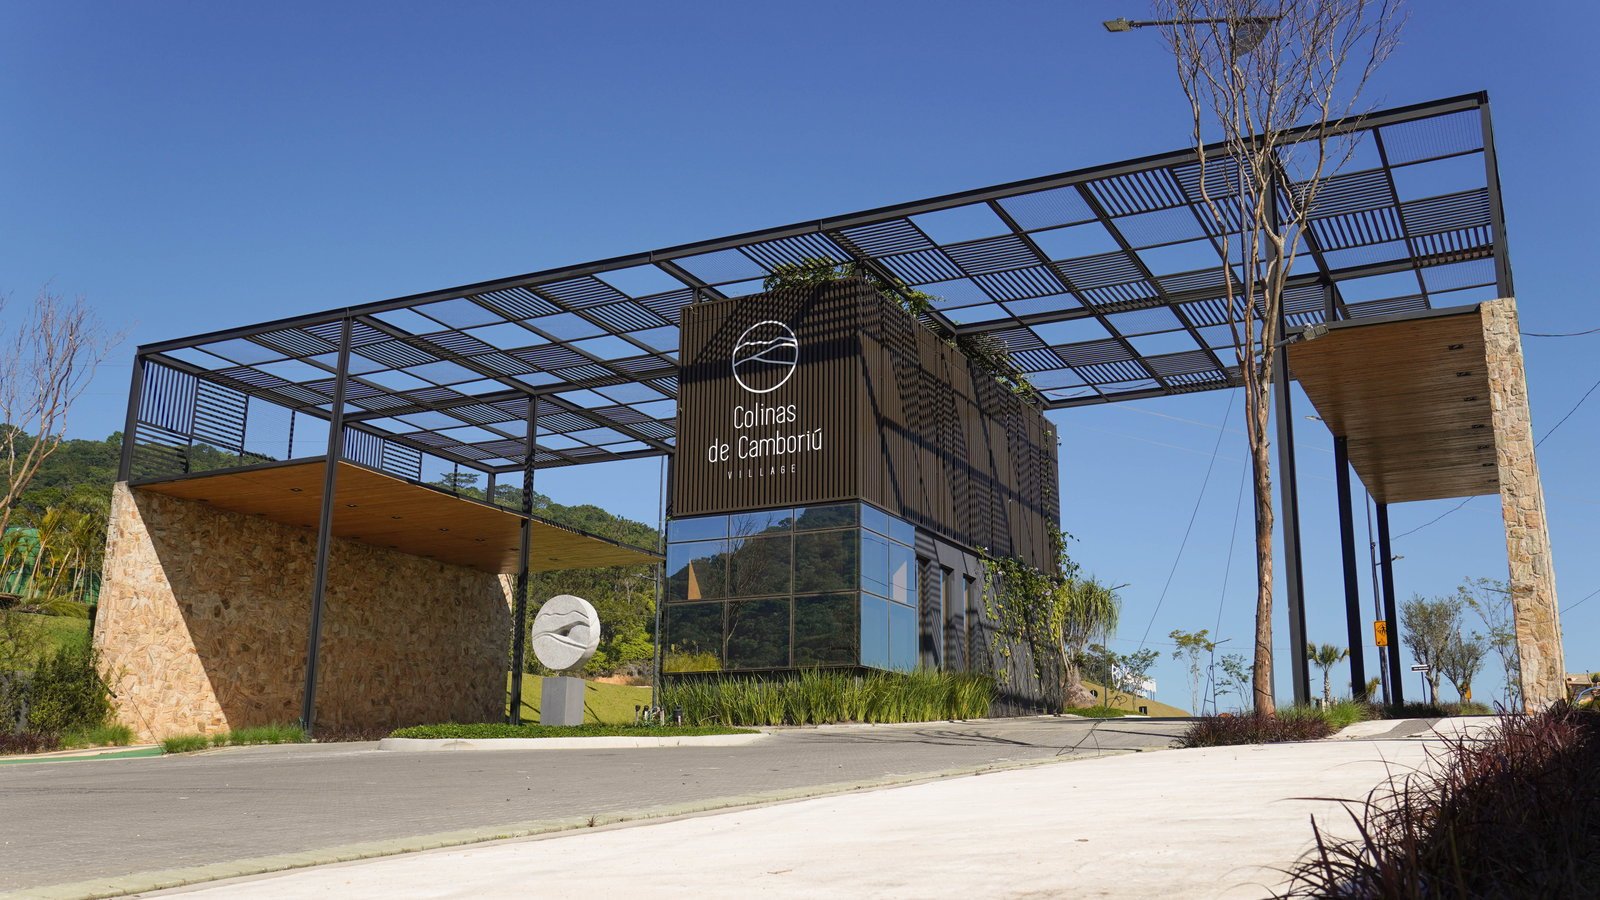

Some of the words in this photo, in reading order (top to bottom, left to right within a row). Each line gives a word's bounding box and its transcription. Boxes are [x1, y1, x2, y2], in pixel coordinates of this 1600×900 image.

[734, 402, 797, 429] Colinas
[708, 438, 729, 463] de
[738, 427, 822, 459] Camboriú
[727, 463, 796, 480] VILLAGE
